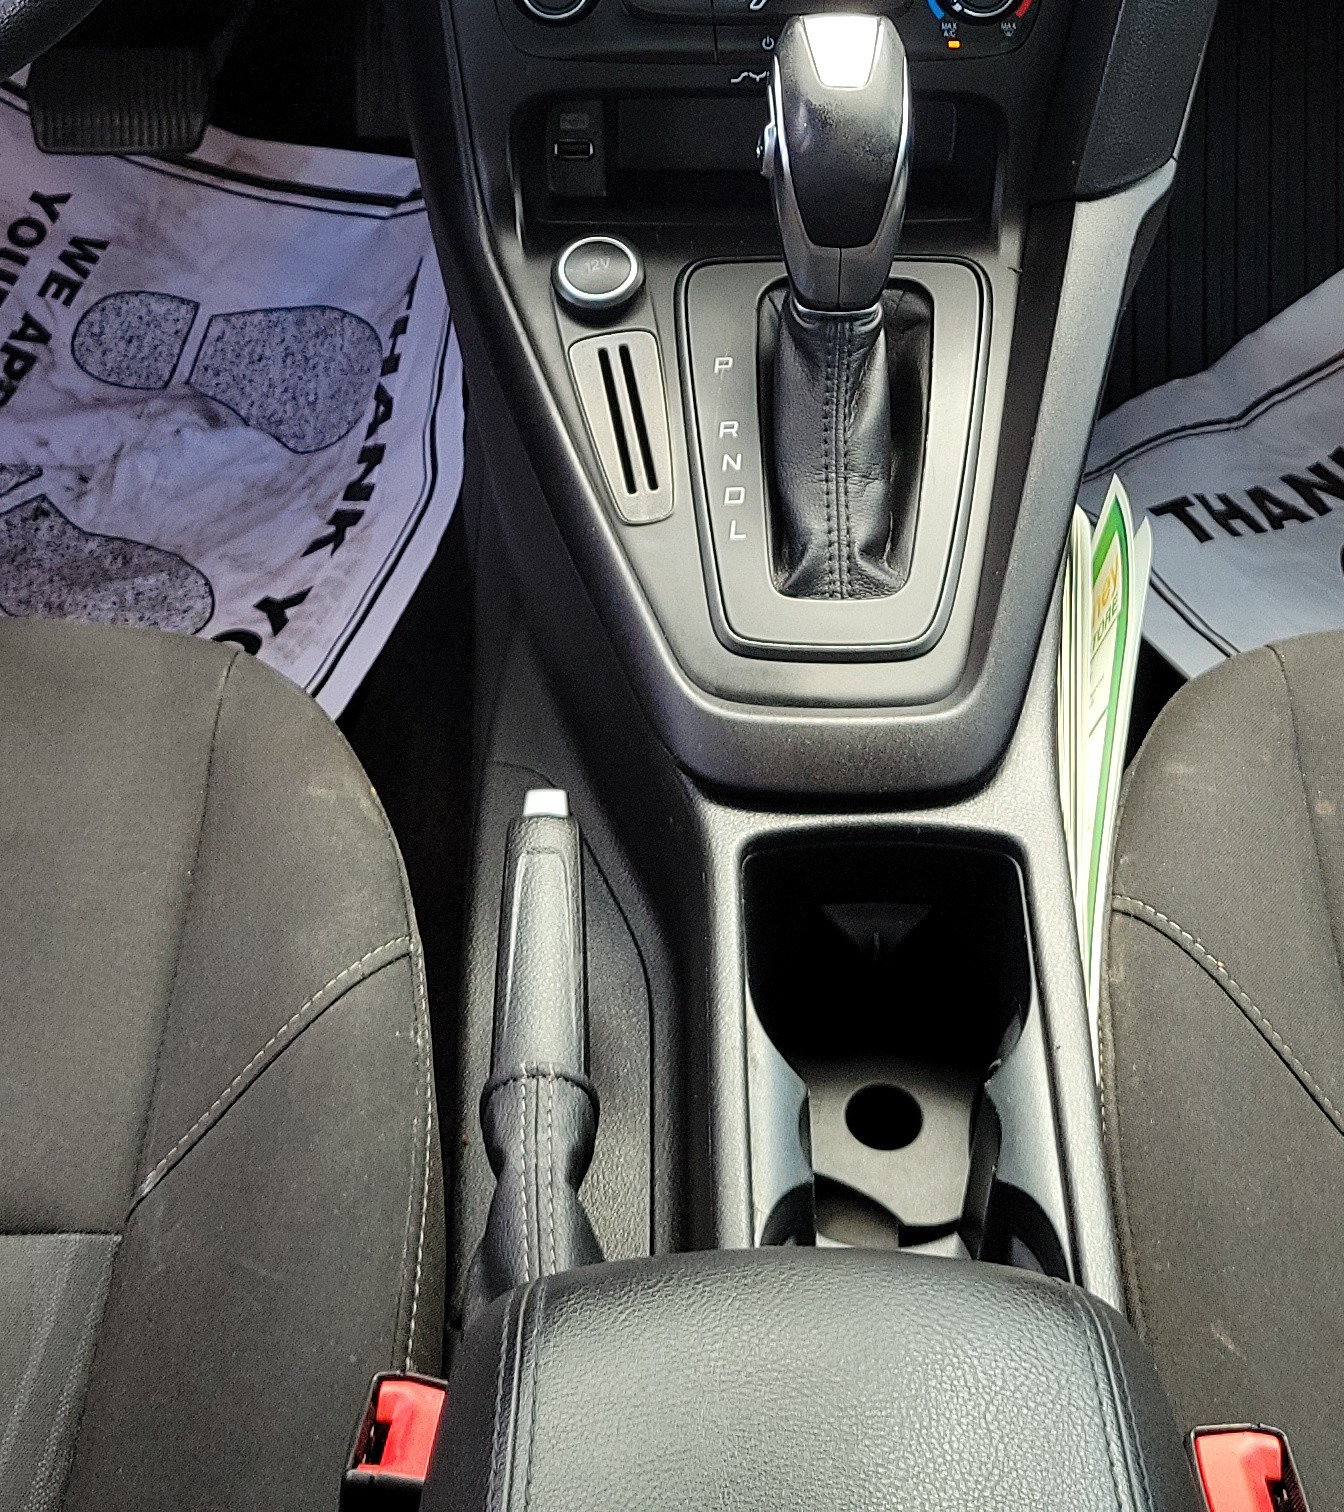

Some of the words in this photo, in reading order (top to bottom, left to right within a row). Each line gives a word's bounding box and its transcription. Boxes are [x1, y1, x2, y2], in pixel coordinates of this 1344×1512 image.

[36, 236, 110, 308] WE
[585, 257, 610, 272] 12V
[714, 356, 733, 374] P
[719, 421, 738, 438] R
[722, 453, 742, 472] N
[724, 487, 745, 505] D
[730, 520, 747, 540] L
